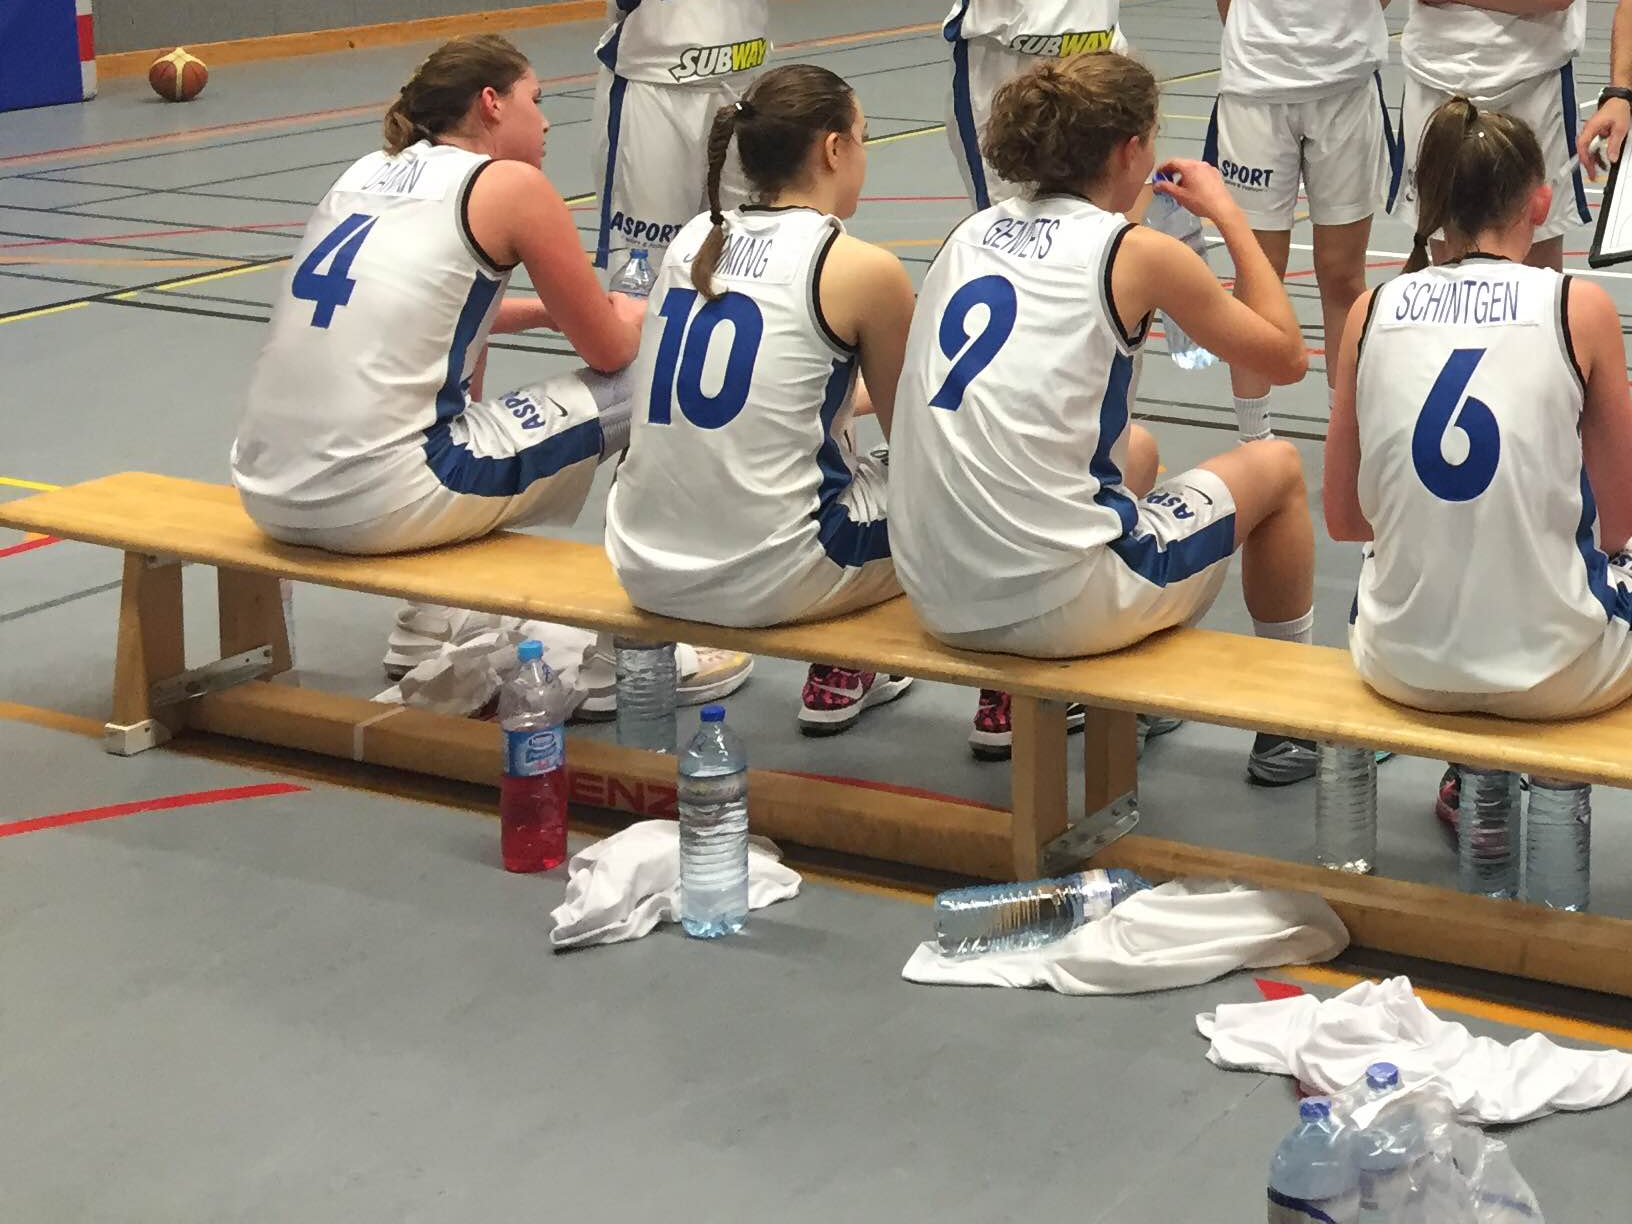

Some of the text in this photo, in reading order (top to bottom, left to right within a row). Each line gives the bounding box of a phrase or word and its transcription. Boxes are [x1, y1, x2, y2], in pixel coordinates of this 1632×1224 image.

[668, 38, 767, 83] SUBWAY
[1009, 27, 1115, 58] SUBWAY
[1221, 159, 1274, 187] SPORT
[292, 213, 380, 328] 4
[1395, 279, 1519, 325] SCHINTGEN
[648, 287, 764, 430] 10
[927, 274, 1018, 412] 9
[1411, 348, 1501, 503] 6
[568, 772, 679, 819] ENZ
